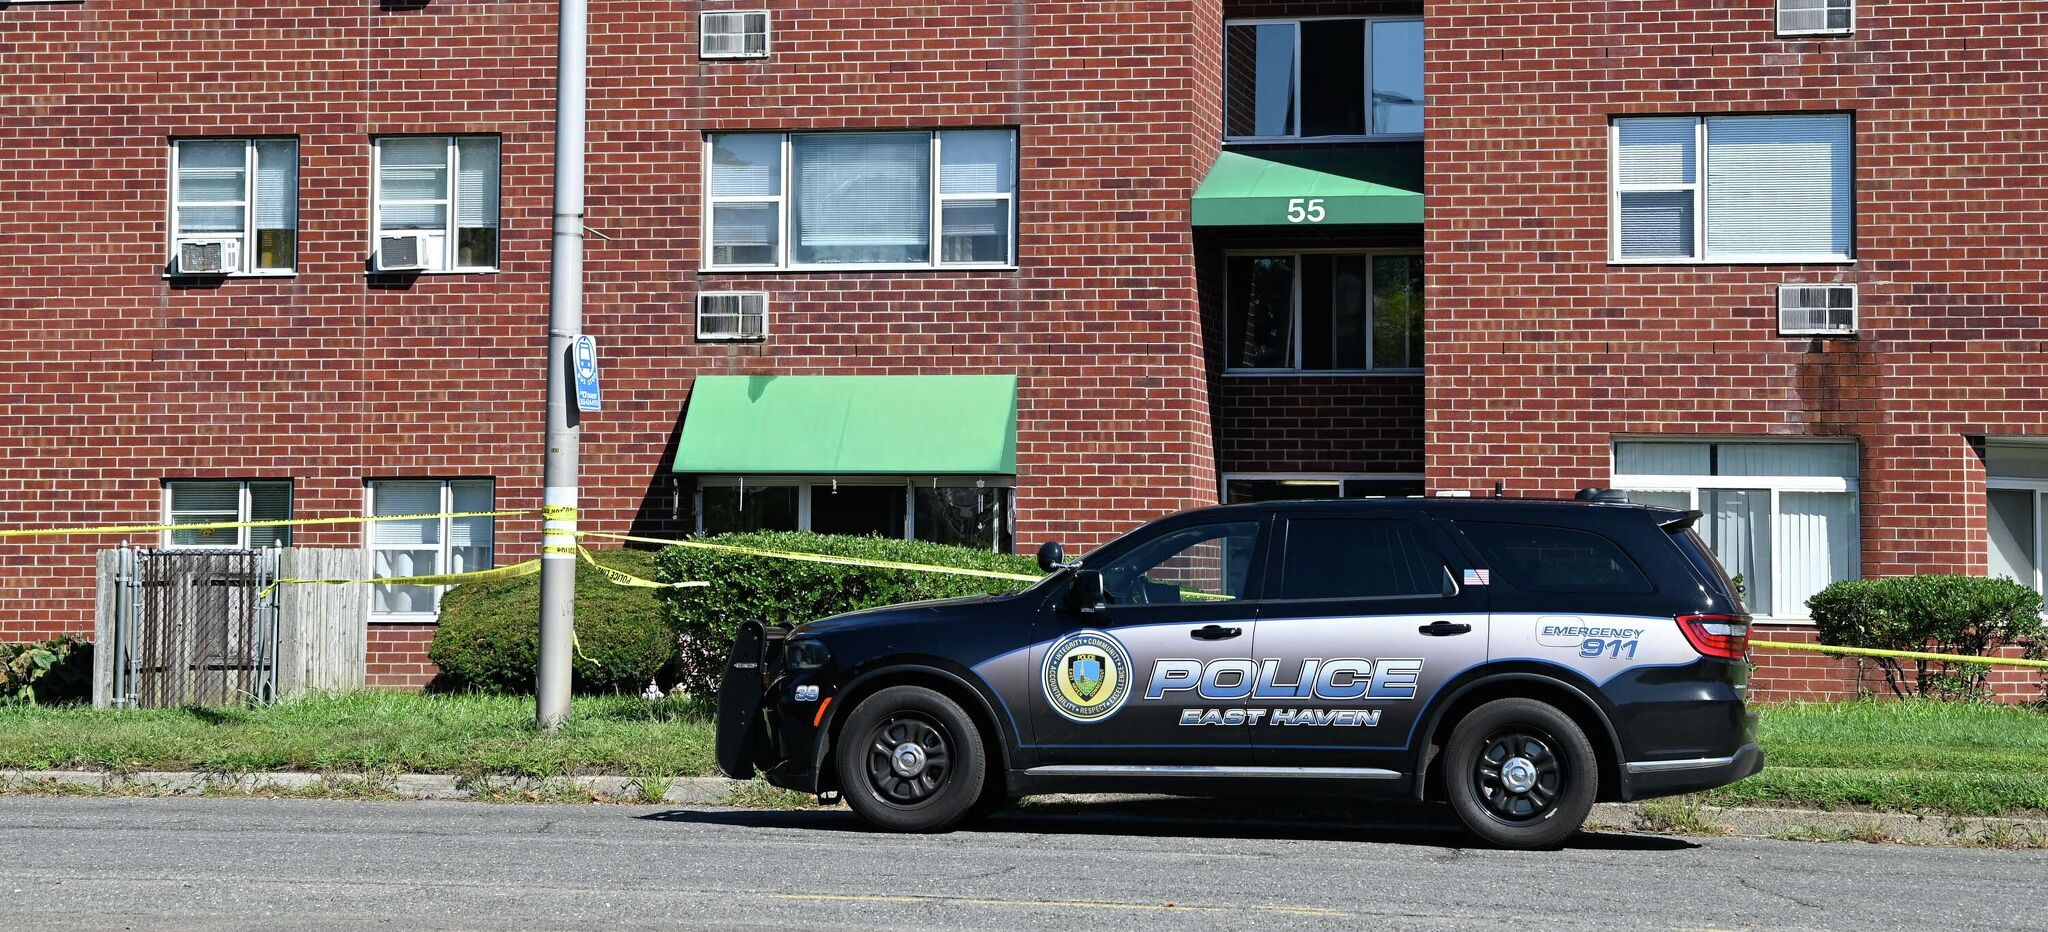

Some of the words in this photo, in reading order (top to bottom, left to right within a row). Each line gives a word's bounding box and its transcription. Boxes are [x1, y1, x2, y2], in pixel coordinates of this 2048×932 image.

[1287, 198, 1326, 223] 55
[609, 571, 632, 584] POLICE
[1542, 625, 1644, 639] EMERGENCY
[1055, 639, 1083, 661] INTEGRITY
[1088, 638, 1121, 662] COMMUNITY
[1579, 638, 1638, 660] 911
[1050, 665, 1076, 711] ACCOUNTABILITY
[1109, 666, 1124, 704] EXCELLENCE
[1144, 658, 1424, 700] POLICE
[1080, 703, 1108, 714] RESPECT
[1179, 708, 1266, 726] EAST
[1270, 708, 1382, 727] HAVEN
